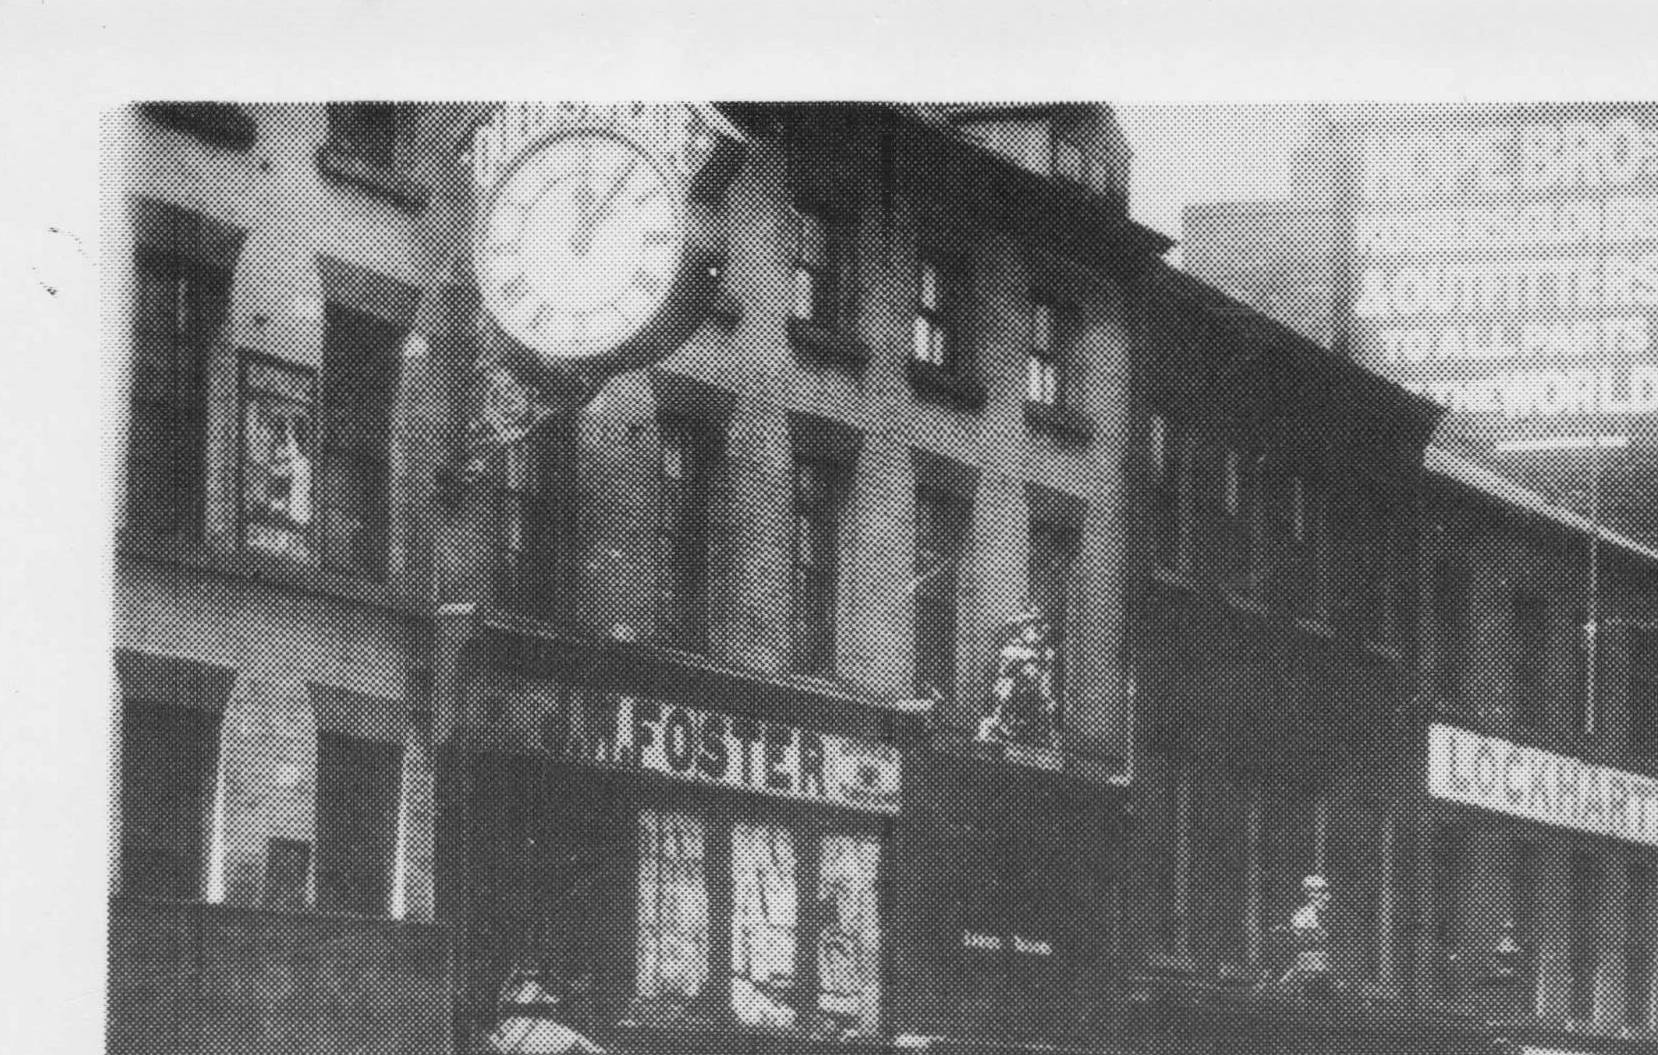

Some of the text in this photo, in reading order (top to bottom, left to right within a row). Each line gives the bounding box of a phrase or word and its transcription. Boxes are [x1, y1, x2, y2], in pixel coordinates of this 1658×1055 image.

[1363, 127, 1511, 200] HOPE
[1380, 317, 1649, 363] TO ALL PARTS
